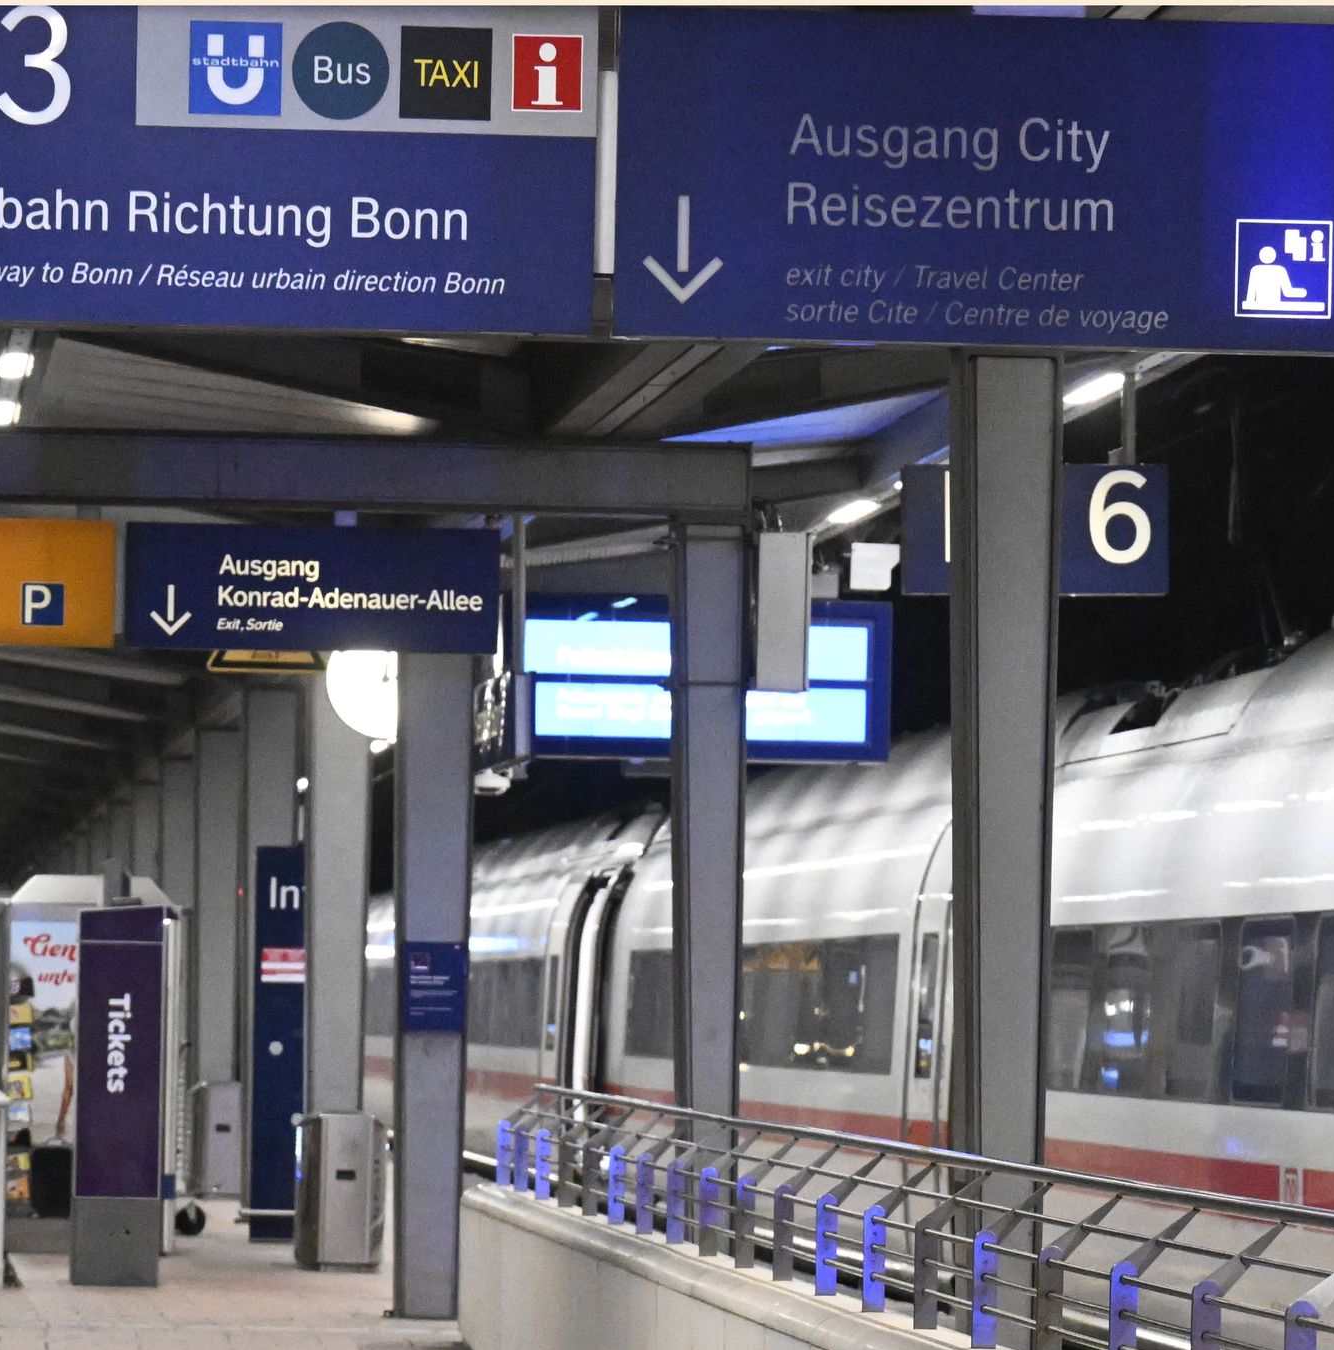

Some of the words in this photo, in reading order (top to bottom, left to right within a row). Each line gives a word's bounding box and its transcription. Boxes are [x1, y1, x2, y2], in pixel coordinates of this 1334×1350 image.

[192, 57, 280, 68] stadtbahn
[312, 55, 372, 86] Bus
[413, 58, 480, 90] TAXI
[788, 112, 1000, 172] Ausgang
[1018, 116, 1111, 174] City
[127, 190, 332, 249] Richtung
[350, 195, 469, 242] Bonn
[786, 181, 1115, 233] Reisezentrum
[41, 261, 65, 285] to
[70, 261, 134, 286] Bonn
[138, 262, 154, 287] /
[155, 262, 243, 290] Réseau
[250, 266, 327, 291] urbain
[332, 268, 438, 294] direction
[442, 271, 507, 296] Bonn
[785, 263, 831, 287] exit
[839, 264, 886, 293] city
[913, 263, 988, 291] Travel
[997, 265, 1085, 293] Center
[784, 299, 860, 324] sortie
[944, 300, 1031, 328] Centre
[1037, 303, 1069, 328] de
[1078, 308, 1170, 336] voyage
[1088, 469, 1152, 565] 6
[219, 552, 321, 581] Ausgang
[23, 583, 52, 625] P
[216, 584, 484, 613] Konrad-Adenauer-Allee
[269, 876, 306, 910] In
[107, 992, 133, 1093] Tickets
